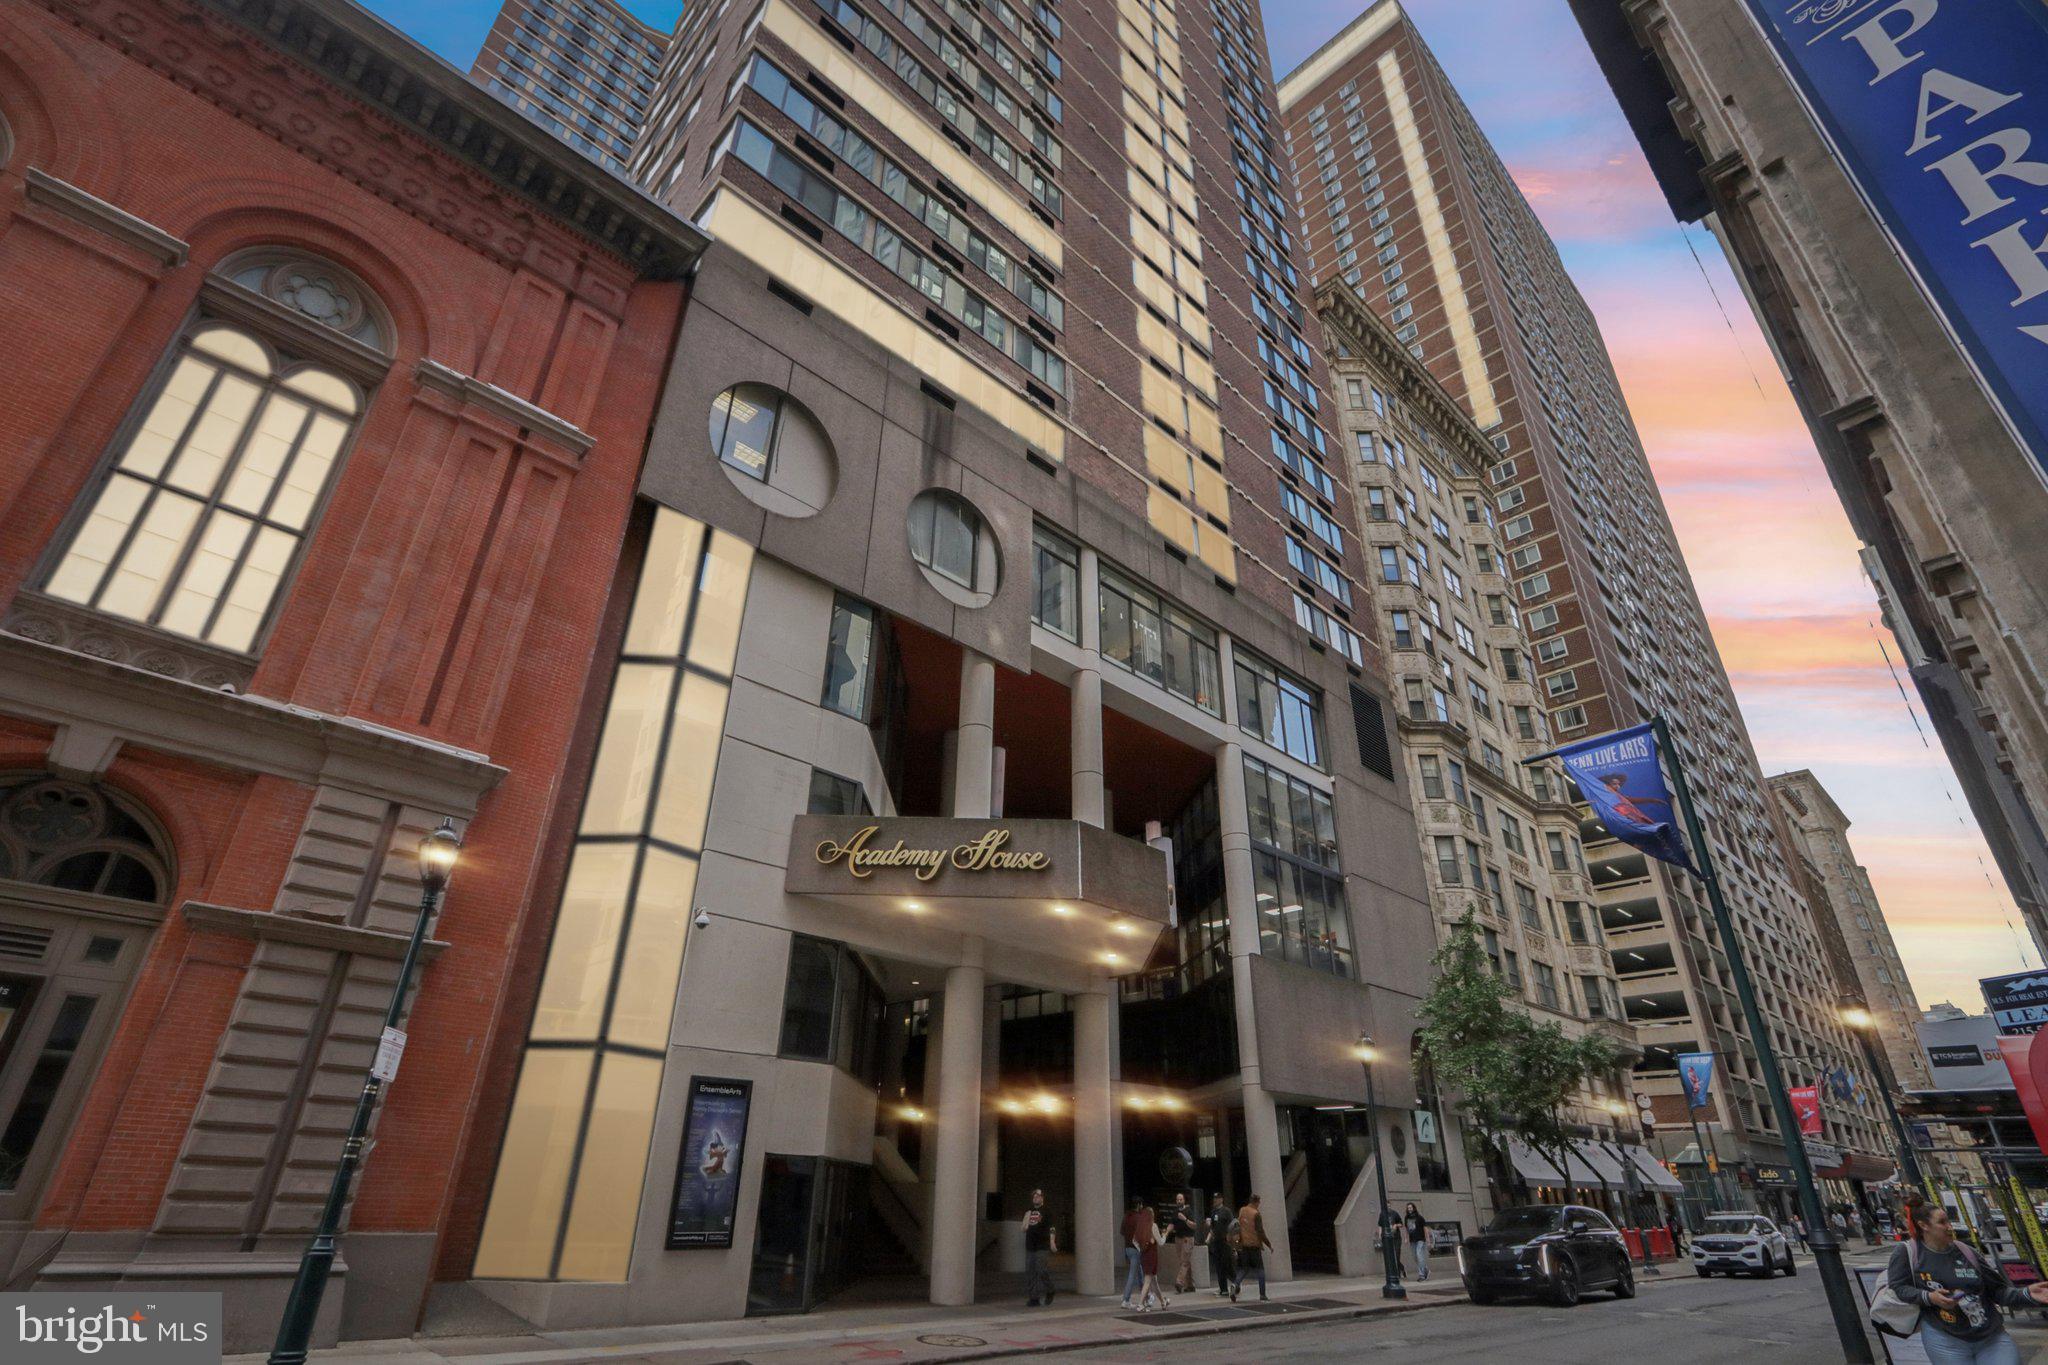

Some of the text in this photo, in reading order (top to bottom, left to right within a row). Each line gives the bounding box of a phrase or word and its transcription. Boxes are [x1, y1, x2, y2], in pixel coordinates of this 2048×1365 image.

[1841, 0, 2048, 345] PARK
[1595, 745, 1618, 765] LIVE
[1619, 736, 1649, 760] ARTS
[815, 826, 1051, 881] Academy House
[2018, 992, 2036, 1001] REAL
[700, 1084, 742, 1096] EnsembleArts
